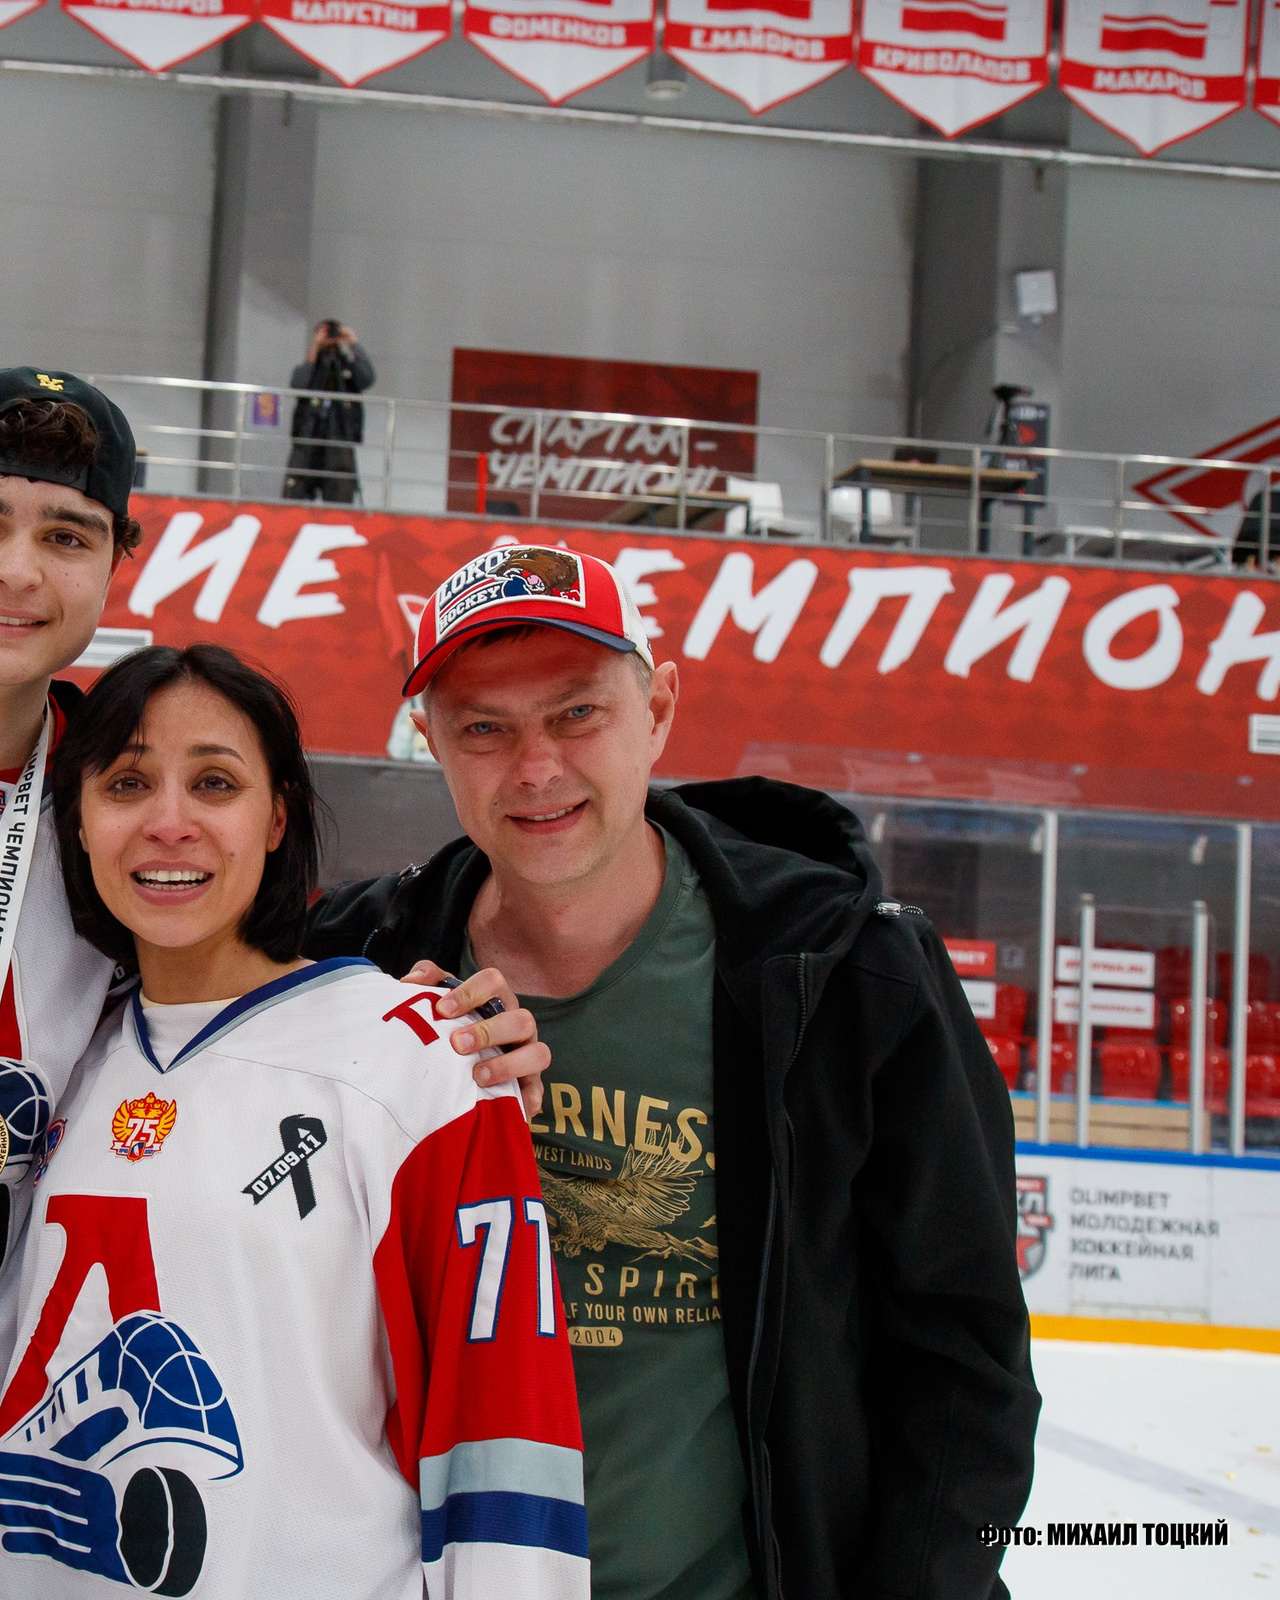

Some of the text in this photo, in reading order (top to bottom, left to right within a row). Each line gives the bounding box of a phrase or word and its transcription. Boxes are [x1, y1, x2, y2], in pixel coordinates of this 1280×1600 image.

[292, 1, 419, 30] КАПУСТИН
[489, 14, 627, 47] ФОМЕНКОВ
[690, 24, 826, 60] Е.МАЙОРОВ
[872, 45, 1031, 82] КРИВОЛАПОВ
[1093, 69, 1207, 99] МАКАРОВ
[439, 585, 501, 632] HOCKEY
[492, 534, 1280, 700] ЕМПИОН
[126, 1118, 159, 1147] 75
[251, 1134, 322, 1196] 07.09.11
[571, 1149, 612, 1172] LANDS
[1071, 1187, 1171, 1210] OLIMPBET
[1071, 1213, 1220, 1238] МОЛОДЕЖНАЯ
[1071, 1235, 1194, 1261] ХОККЕЙНАЯ
[1071, 1263, 1122, 1282] ЛИГА
[584, 1303, 625, 1322] YOUR
[632, 1306, 668, 1323] OWN
[573, 1329, 617, 1344] 2004
